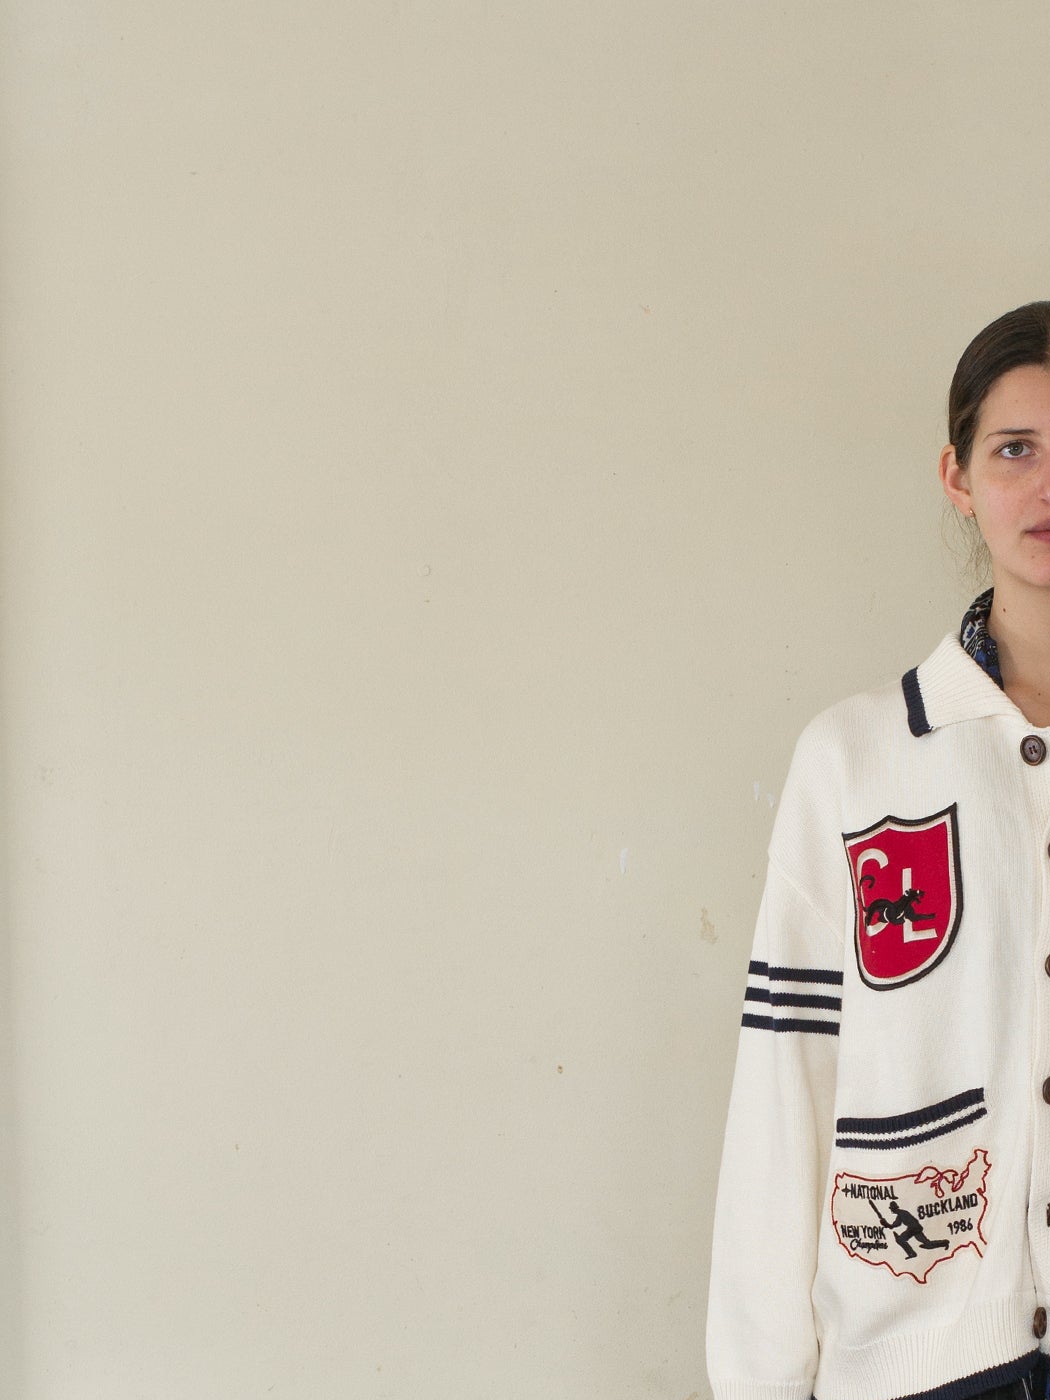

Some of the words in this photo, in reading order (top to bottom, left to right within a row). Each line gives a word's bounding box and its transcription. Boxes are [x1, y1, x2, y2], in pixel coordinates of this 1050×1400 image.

[917, 1193, 979, 1220] BUCKLAND
[840, 1224, 861, 1239] NEW
[862, 1225, 886, 1240] YORK
[947, 1218, 973, 1235] 1986
